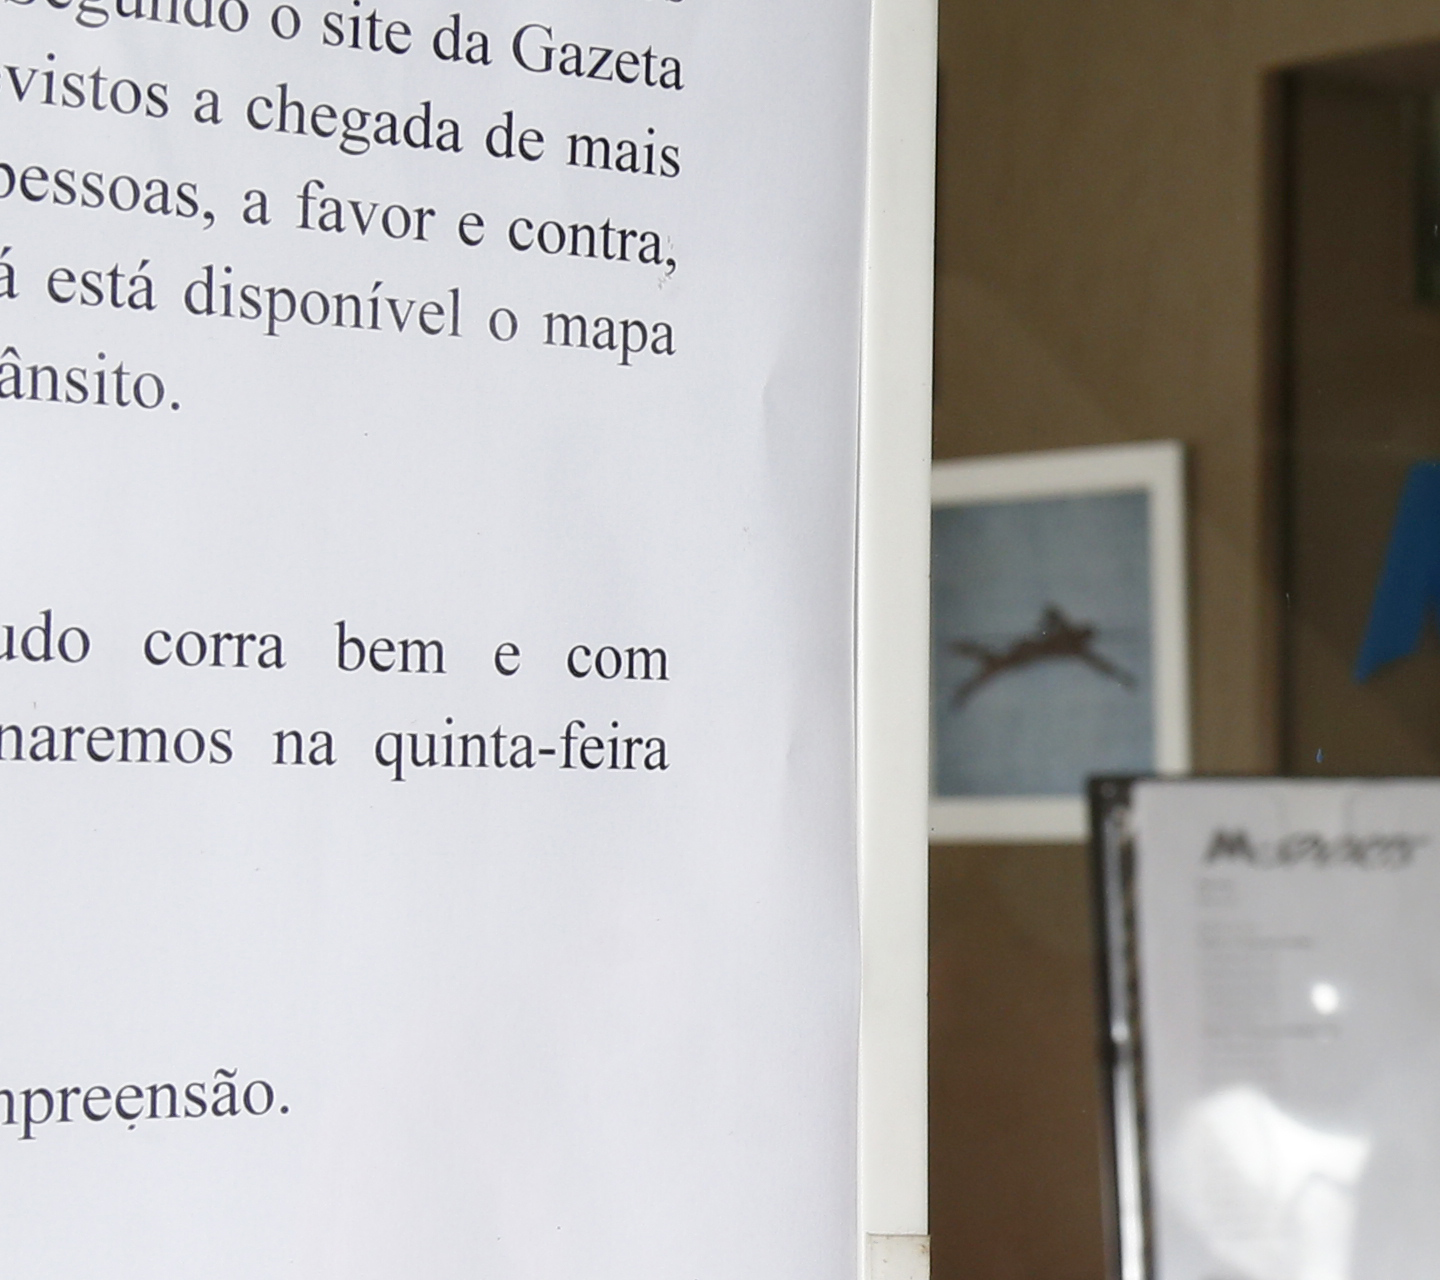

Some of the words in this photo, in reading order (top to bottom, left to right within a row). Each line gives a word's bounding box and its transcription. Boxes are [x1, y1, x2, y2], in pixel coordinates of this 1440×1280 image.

[268, 2, 302, 41] o
[320, 6, 413, 56] site
[430, 10, 494, 67] da
[510, 21, 686, 92] Gazeta
[191, 87, 224, 127] a
[244, 80, 465, 157] chegada
[483, 108, 546, 163] de
[564, 131, 682, 179] mais
[240, 187, 273, 227] a
[294, 177, 438, 243] favor
[456, 210, 486, 248] e
[506, 215, 678, 278] contra,
[45, 261, 159, 313] está
[182, 262, 462, 339] disponível
[486, 305, 519, 343] o
[540, 310, 678, 368] mapa
[141, 627, 288, 671] corra
[332, 617, 448, 675] bem
[492, 640, 522, 678] e
[564, 642, 671, 682] com
[270, 727, 338, 767] na
[372, 717, 671, 783] quinta-feira
